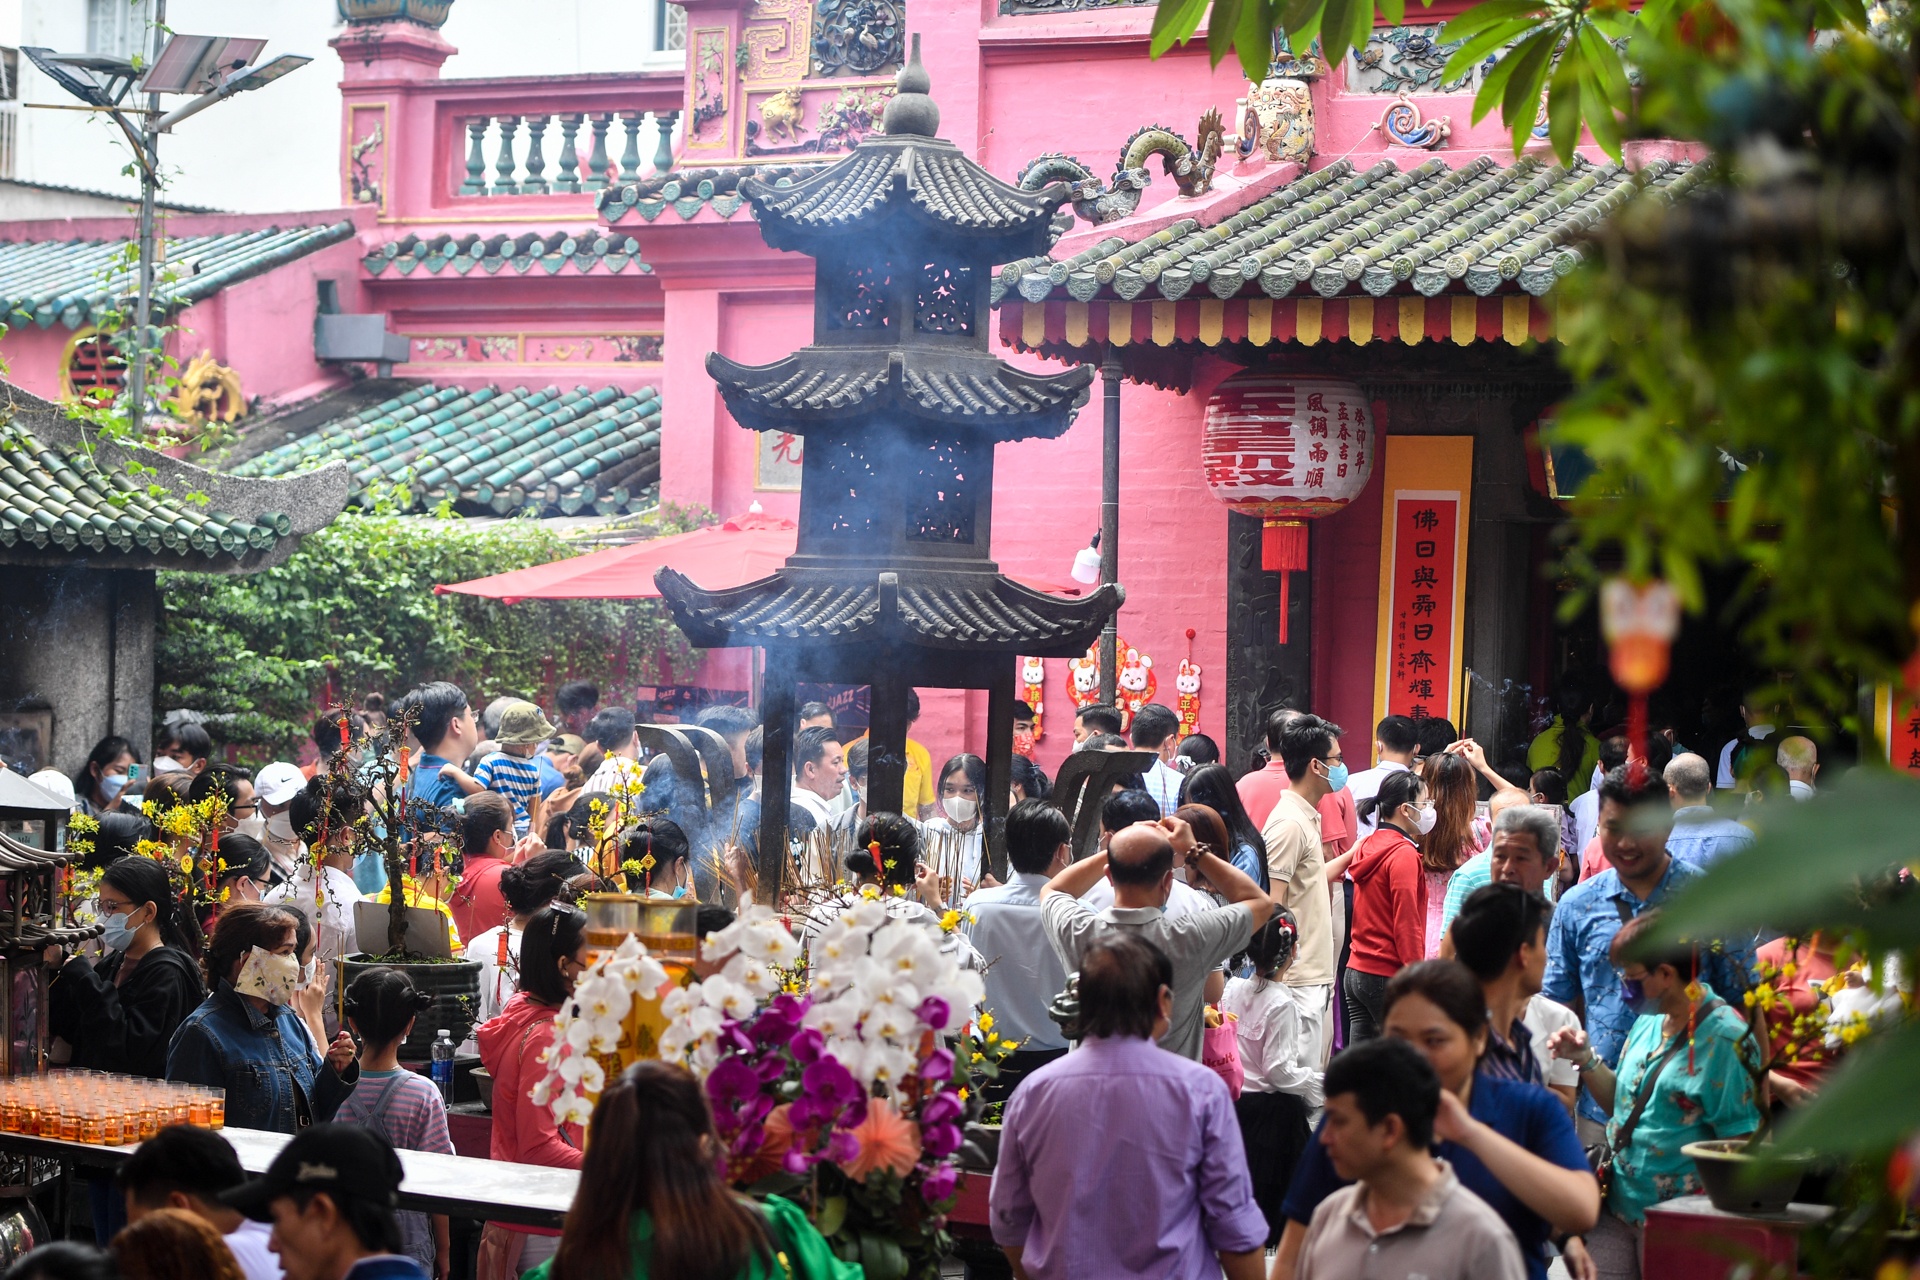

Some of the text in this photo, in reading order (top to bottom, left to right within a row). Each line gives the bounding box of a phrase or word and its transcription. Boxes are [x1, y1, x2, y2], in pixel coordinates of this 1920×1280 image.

[1304, 393, 1329, 488] 風調雨順
[1337, 402, 1352, 478] 孟春吉日
[1355, 408, 1366, 474] 癸卯年
[828, 689, 854, 710] JAZZ
[552, 914, 560, 935] CHANEL
